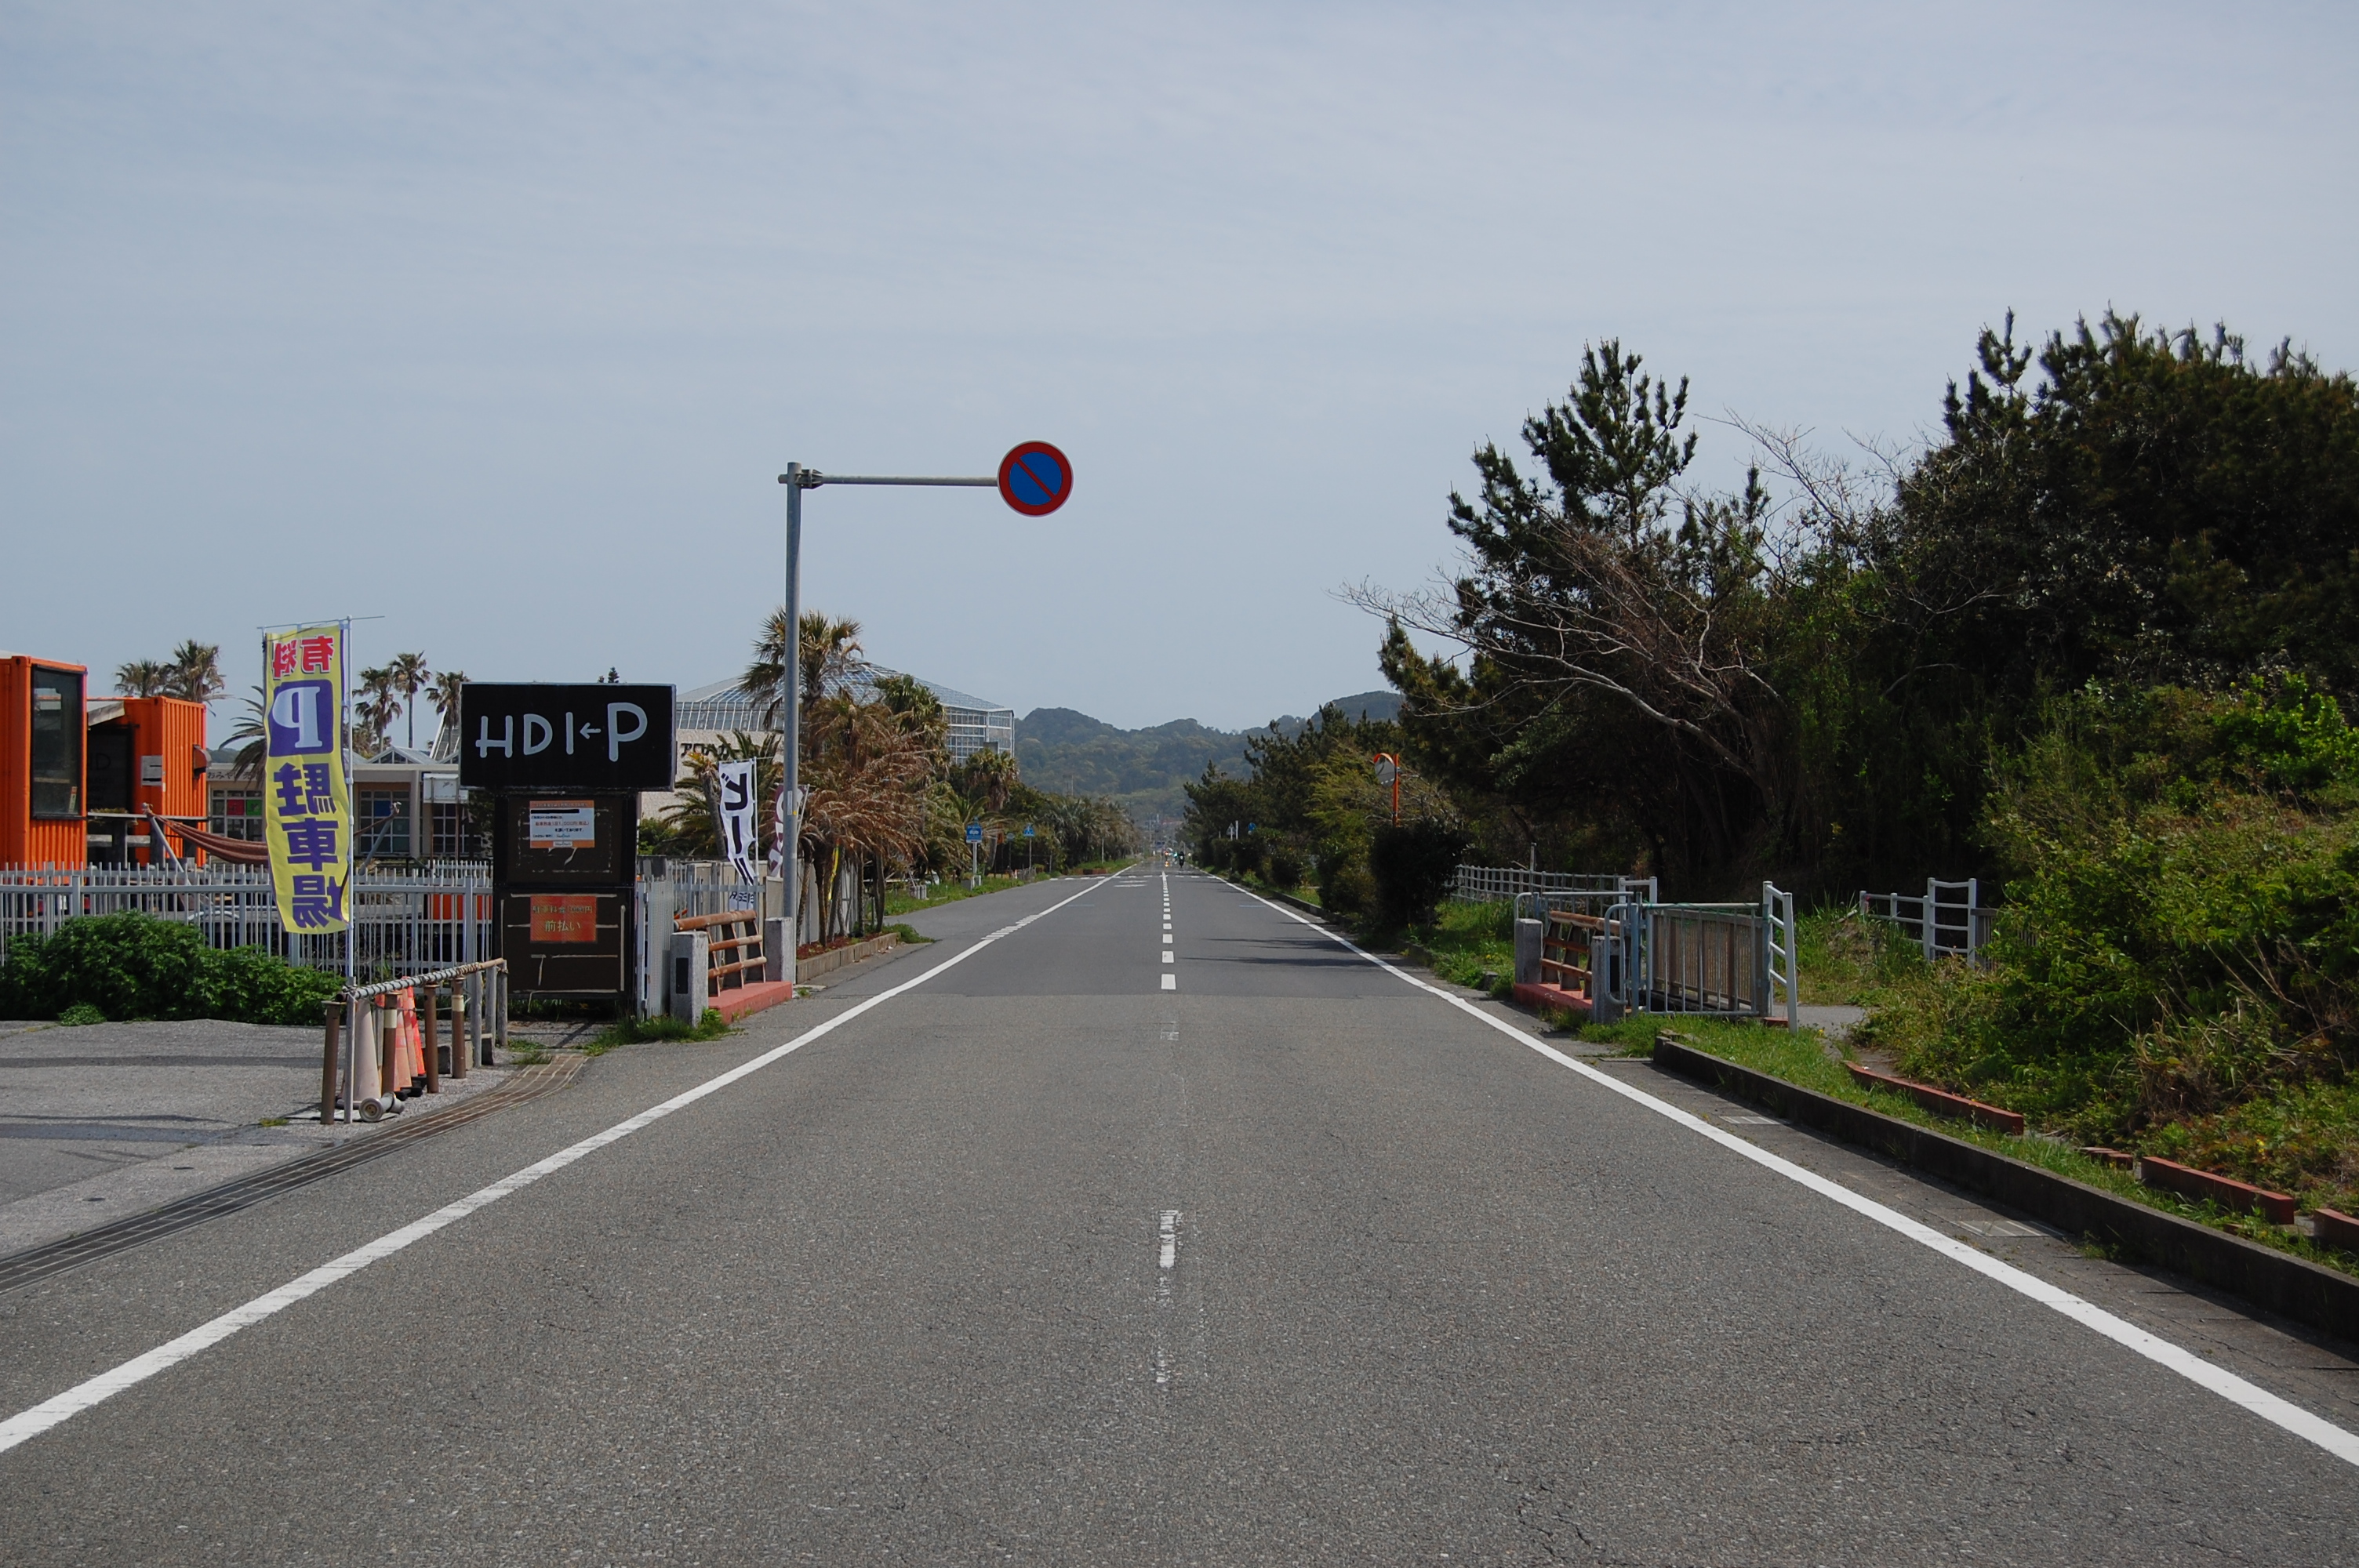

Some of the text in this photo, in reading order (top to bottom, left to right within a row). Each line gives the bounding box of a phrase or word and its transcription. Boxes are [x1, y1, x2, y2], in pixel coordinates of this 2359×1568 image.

[607, 702, 648, 762] P
[545, 920, 581, 931] 前払い
